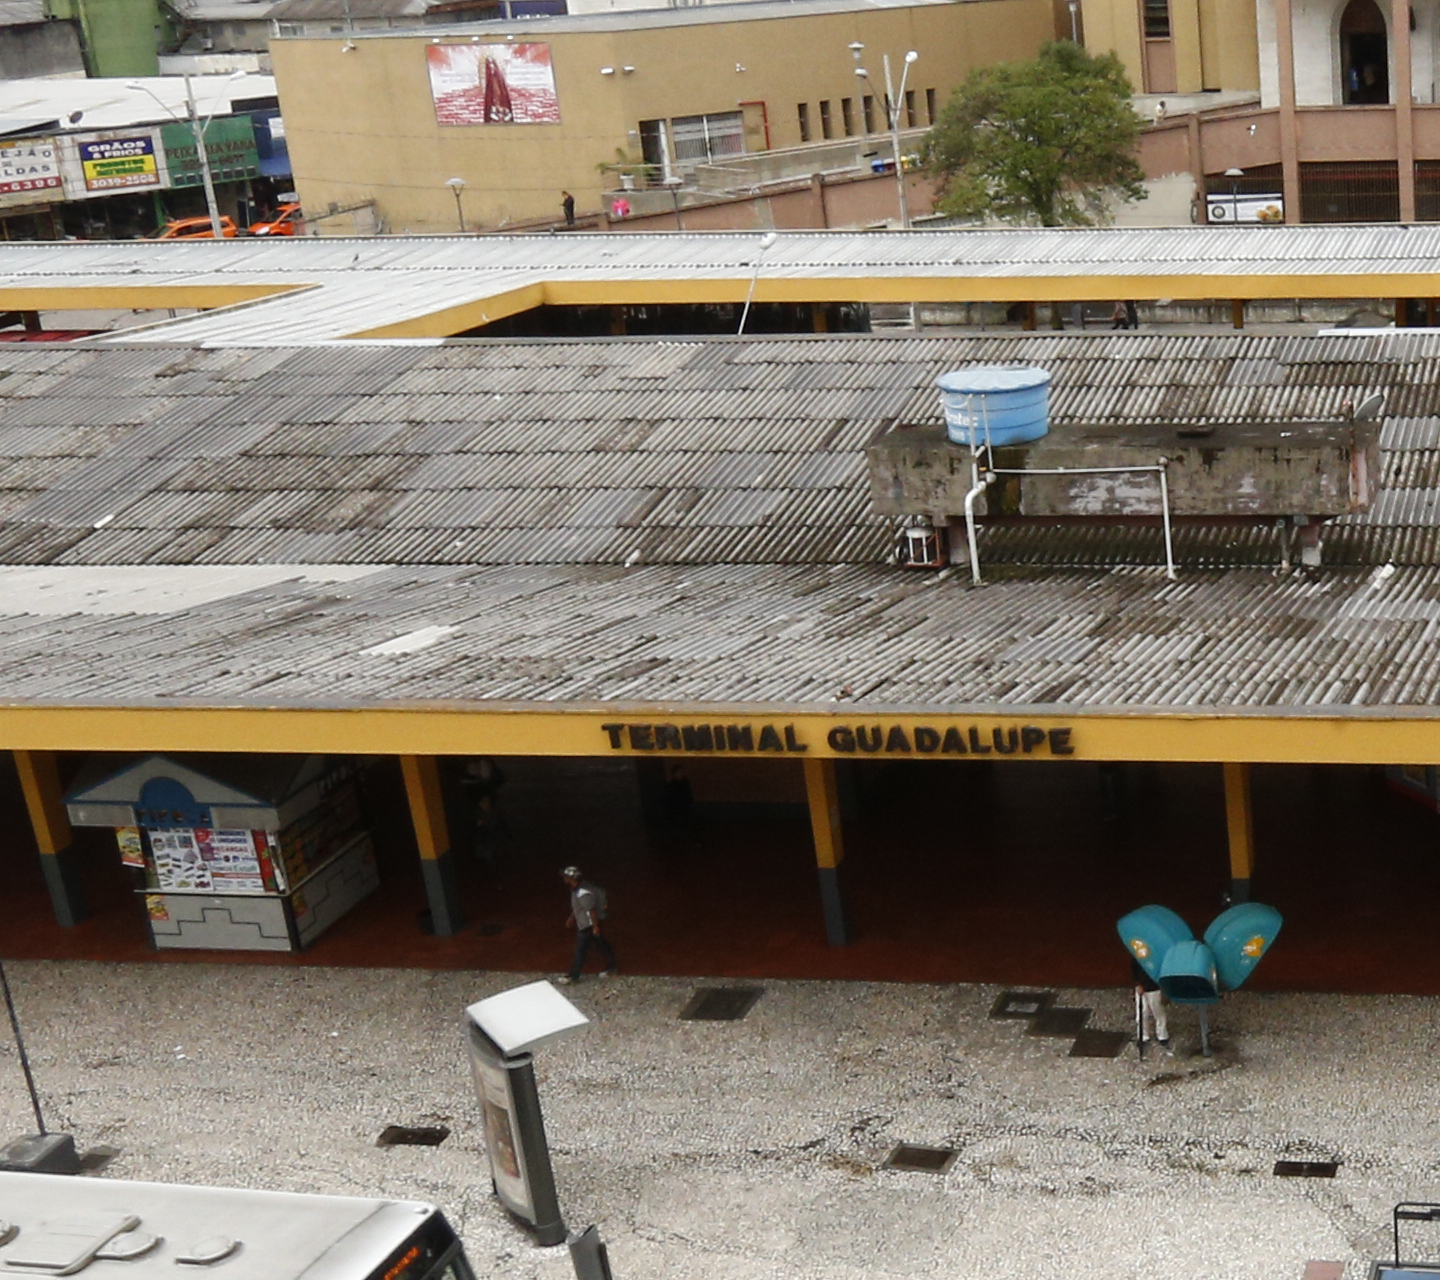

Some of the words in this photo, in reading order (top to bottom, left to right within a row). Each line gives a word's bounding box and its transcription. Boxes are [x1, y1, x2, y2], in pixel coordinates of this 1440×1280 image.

[87, 141, 146, 153] GRÃOS
[104, 149, 144, 158] FRIOS
[601, 723, 808, 752] TERMINAL
[827, 724, 1076, 755] GUADALUPE
